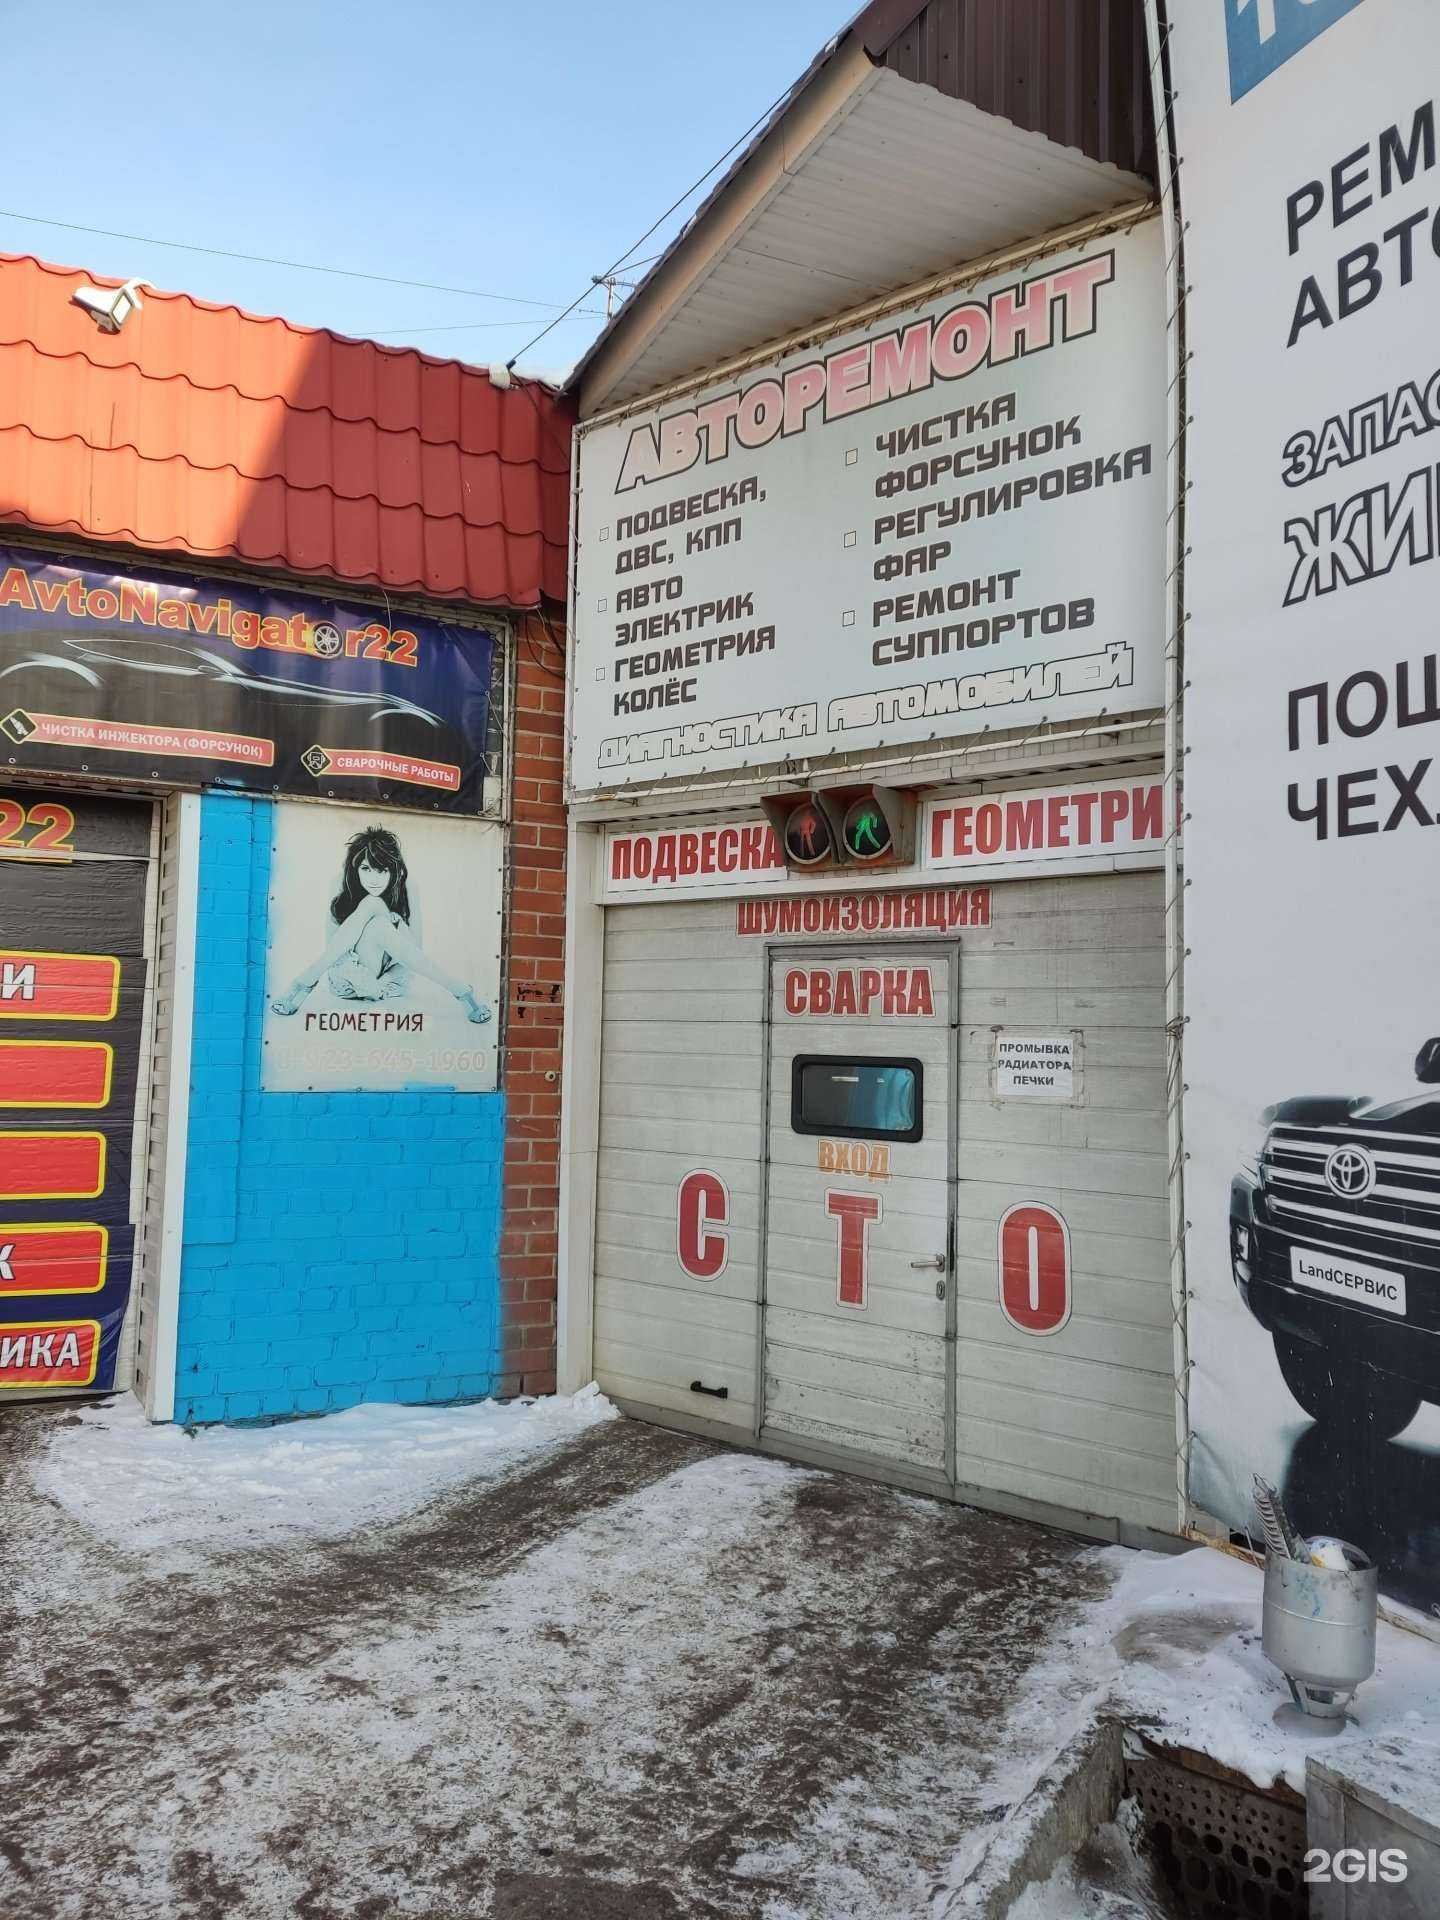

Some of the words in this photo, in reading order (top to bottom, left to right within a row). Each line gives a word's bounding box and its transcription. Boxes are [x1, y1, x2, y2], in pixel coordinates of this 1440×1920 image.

[1287, 204, 1440, 348] АВТ
[615, 249, 1115, 494] АВТОРЕМОНТ
[875, 392, 1016, 458] ЧИСТКА
[875, 415, 1081, 498] ФОРСУНОК
[616, 475, 767, 541] ПОДВЕСКА,
[874, 444, 1152, 544] РЕГУЛИРОВКА
[614, 539, 675, 575] ДВС,
[686, 517, 742, 555] КПП
[873, 541, 951, 582] ФАР
[615, 592, 754, 647] ЭЛЕКТРИК
[616, 575, 683, 613] АВТО
[873, 569, 1021, 627] РЕМОНТ
[614, 625, 776, 682] ГЕОМЕТРИЯ
[872, 598, 1095, 666] СУППОРТОВ
[598, 702, 818, 768] ДИАГНОСТИКА
[828, 641, 1134, 732] АВТОМОБИЛЕЙ
[613, 677, 697, 716] КОЛЁС
[41, 722, 95, 739] ЧИСТКА
[98, 730, 181, 748] ИНЖЕКТОРА
[184, 736, 263, 760] (ФОРСУНОК)
[337, 757, 409, 774] СВАРОЧНЫЕ
[410, 765, 454, 783] РАБОТЫ
[612, 825, 787, 884] ПОДВЕСКА
[736, 888, 991, 936] ШУМОИЗОЛЯЦИЯ
[784, 967, 935, 1018] СВАРКА
[305, 1012, 424, 1033] ГЕОМЕТРИЯ
[998, 1042, 1070, 1056] ПРОМЫВКА
[997, 1058, 1072, 1072] РАДИАТОРА
[1012, 1074, 1055, 1087] ПЕЧКИ
[818, 1140, 893, 1184] ВХОД
